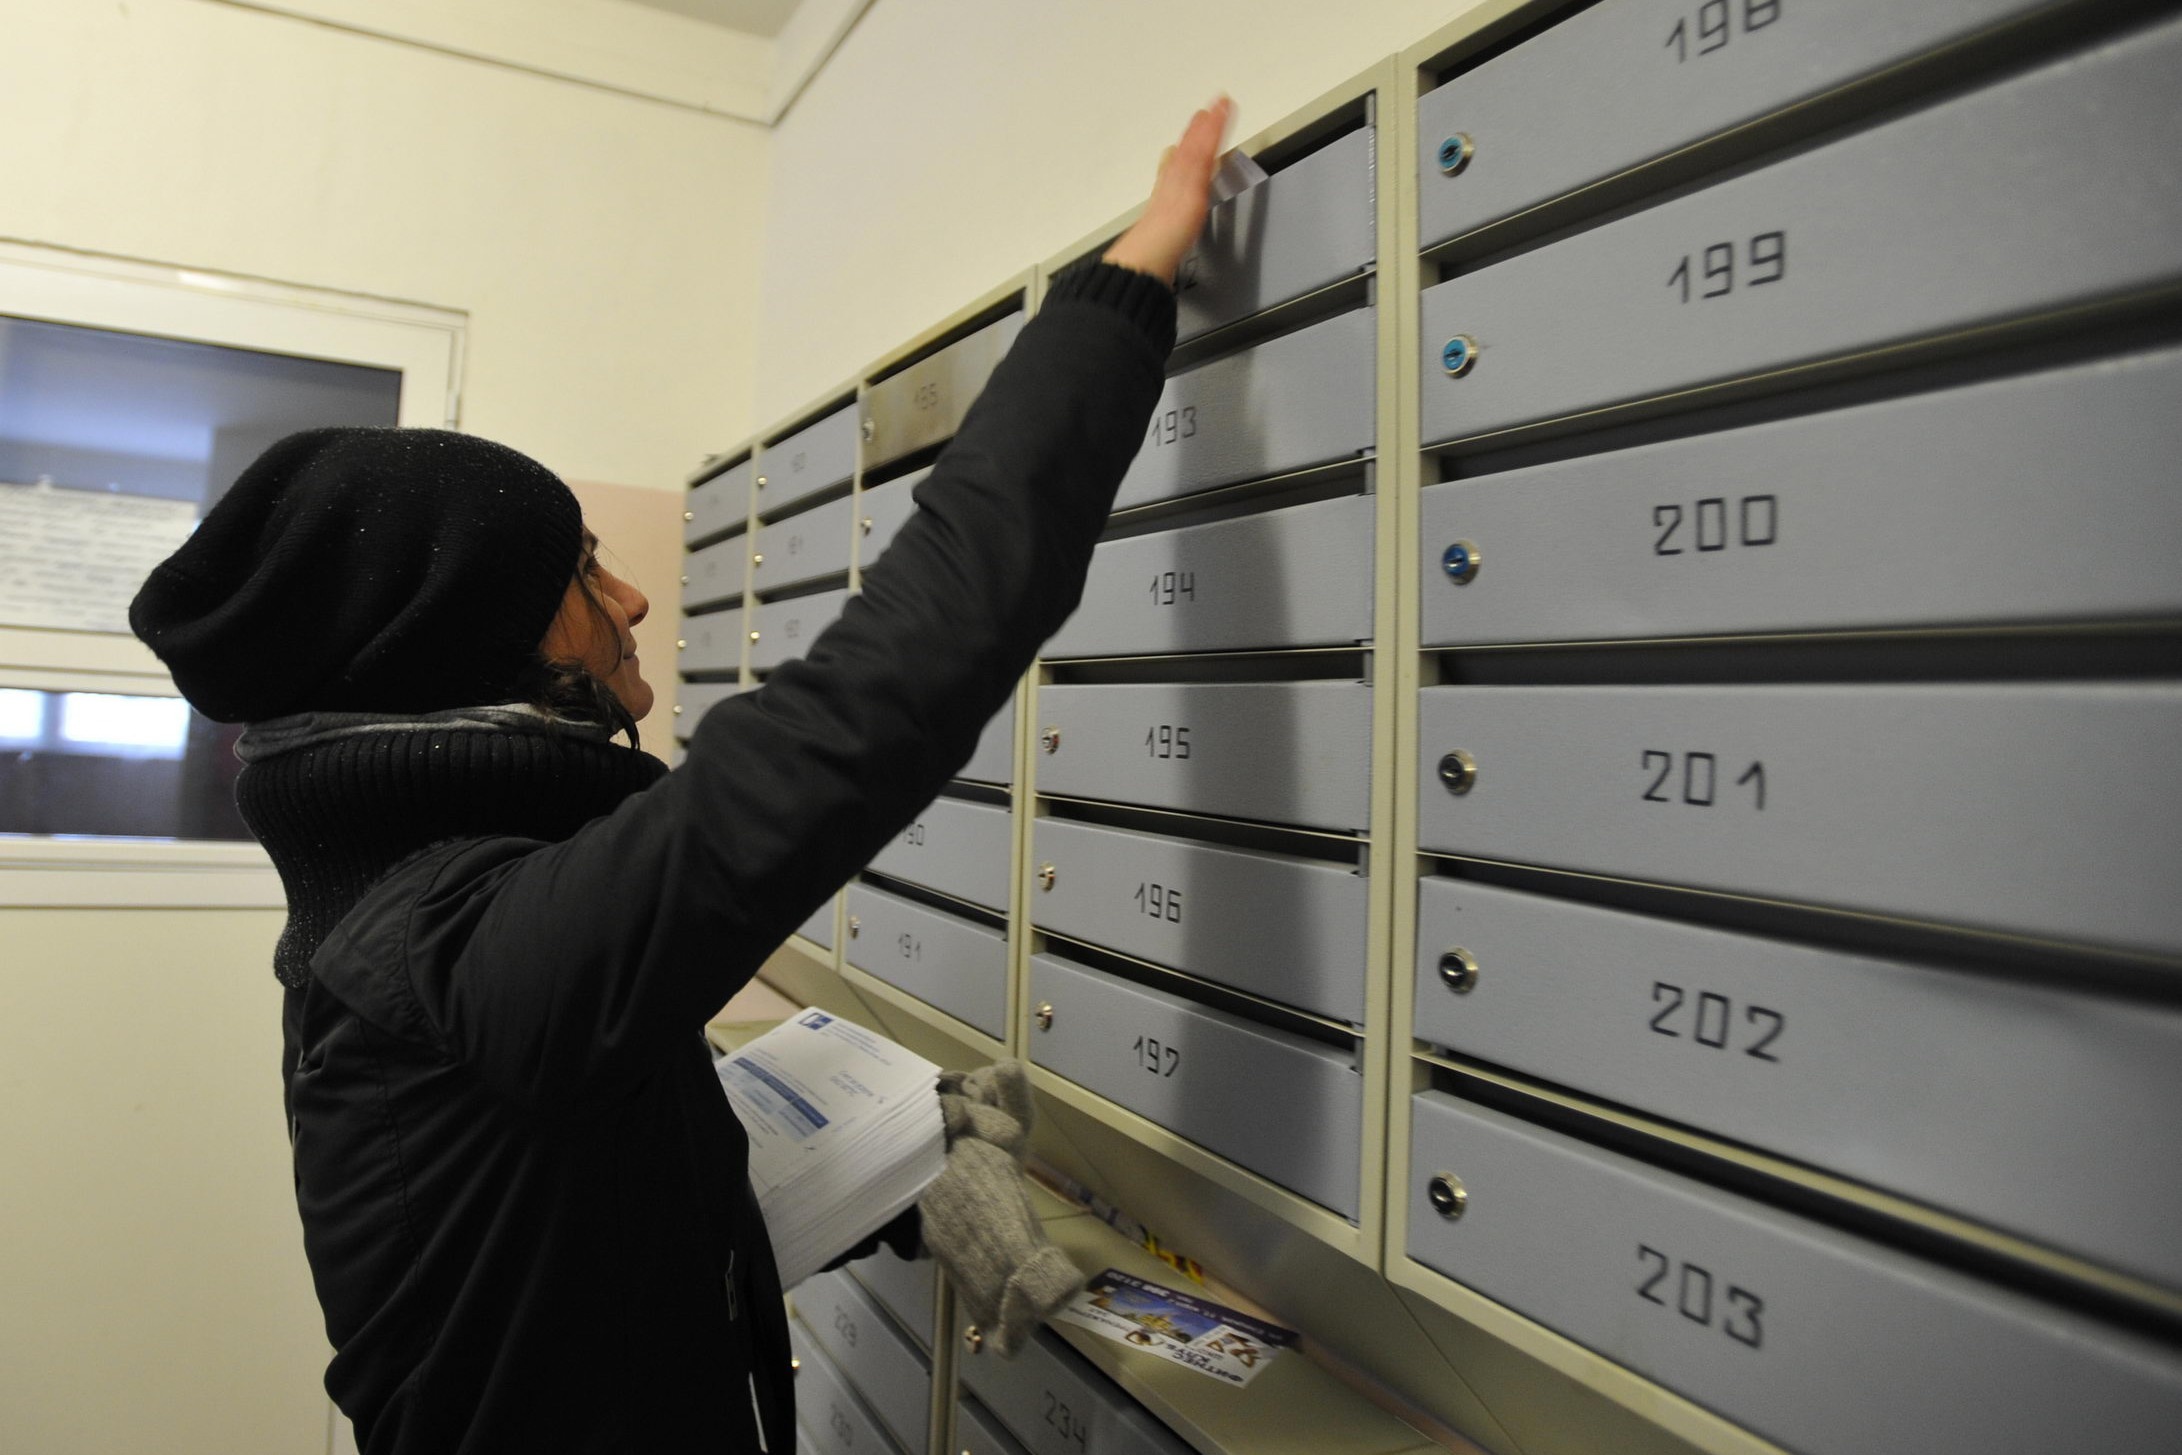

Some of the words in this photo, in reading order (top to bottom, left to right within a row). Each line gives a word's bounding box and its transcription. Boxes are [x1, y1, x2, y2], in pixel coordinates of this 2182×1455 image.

[1664, 0, 1781, 64] 198
[1667, 230, 1785, 304] 199
[1151, 405, 1196, 447] 193
[1653, 494, 1775, 556] 200
[1149, 571, 1194, 606] 194
[1145, 725, 1190, 759] 195
[1641, 749, 1765, 811] 201
[1134, 882, 1182, 923] 196
[897, 932, 921, 963] 191
[1649, 980, 1784, 1063] 202
[1133, 1035, 1180, 1078] 197
[1637, 1243, 1763, 1350] 203
[1045, 1390, 1086, 1454] 234
